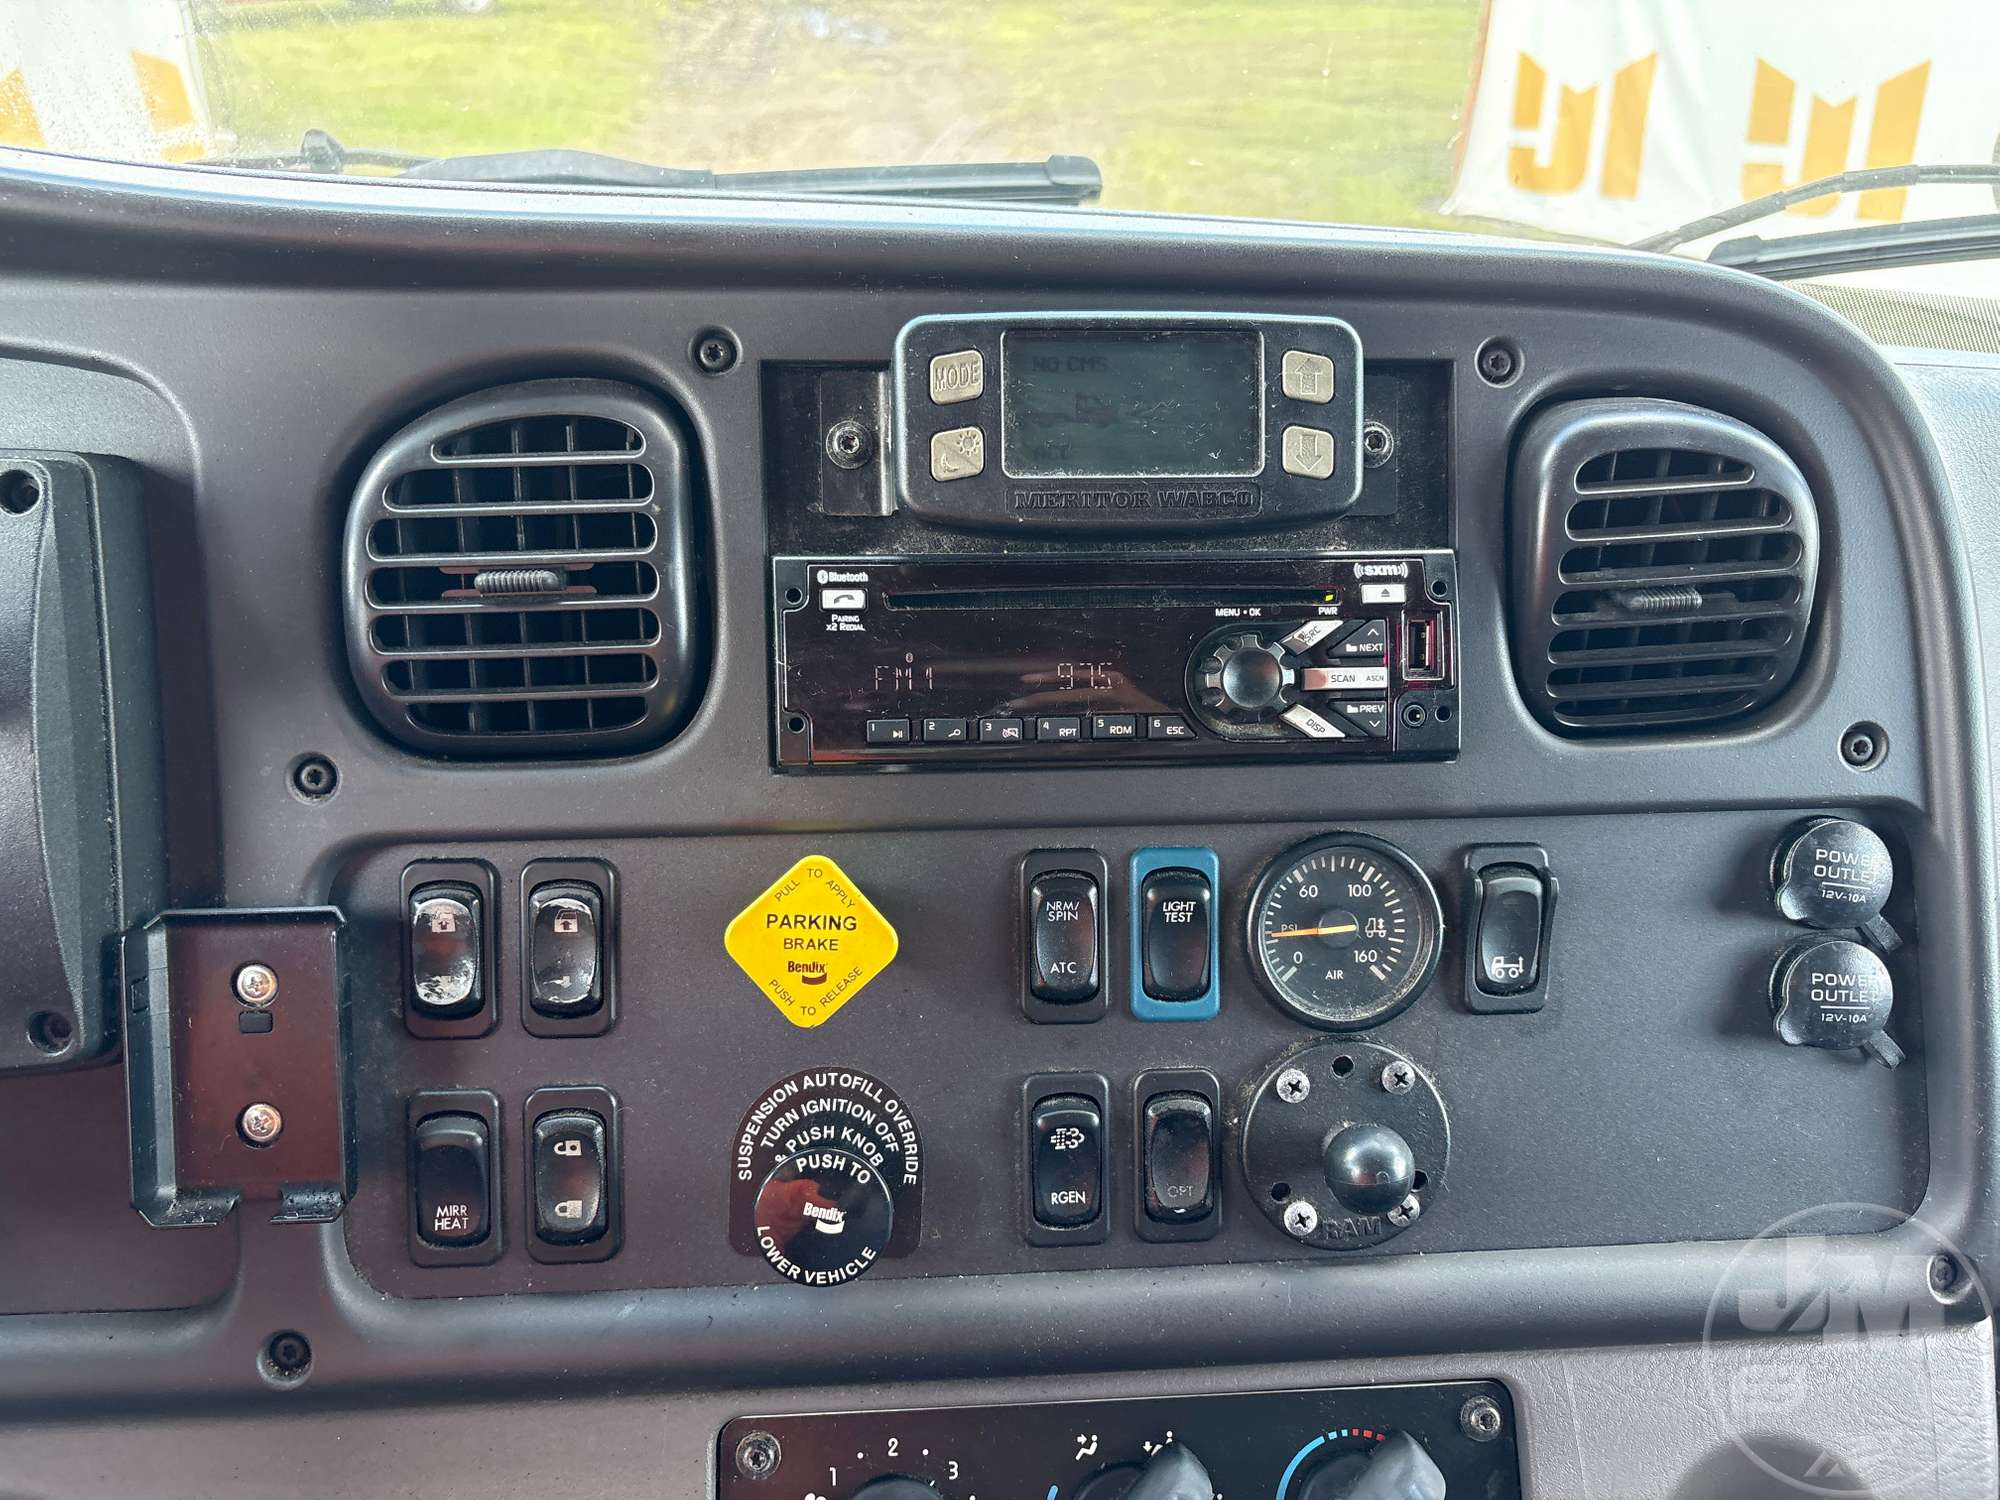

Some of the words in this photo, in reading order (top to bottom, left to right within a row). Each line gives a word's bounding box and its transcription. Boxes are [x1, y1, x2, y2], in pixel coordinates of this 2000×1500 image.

[934, 360, 980, 391] MODE
[1015, 490, 1152, 509] MERITOR
[1156, 490, 1254, 508] WABCO
[828, 571, 869, 582] Bluetooth
[1215, 608, 1240, 617] MENU
[1249, 607, 1261, 616] OK
[1318, 606, 1338, 615] PWR
[1359, 643, 1384, 652] NEXT
[1330, 674, 1355, 683] SCAN
[1359, 704, 1384, 713] PREV
[871, 723, 876, 731] 1
[928, 722, 936, 731] 2
[985, 722, 992, 731] 3
[1042, 721, 1050, 730] 4
[1097, 719, 1105, 728] 5
[1109, 725, 1132, 734] RDM
[1153, 719, 1161, 728] 6
[1166, 726, 1185, 735] ESC
[1306, 718, 1326, 733] DISP
[1059, 728, 1077, 737] RPT
[1813, 865, 1880, 883] OUTLET
[774, 879, 801, 902] PULL
[807, 868, 823, 879] TO
[825, 879, 856, 908] APPLY
[1299, 884, 1319, 898] 60
[1348, 884, 1372, 898] 100
[1822, 889, 1867, 904] 12V-10A
[1162, 901, 1197, 912] LIGHT
[766, 913, 857, 931] PARKING
[1047, 911, 1079, 922] SPIN
[1164, 912, 1193, 923] TEST
[783, 937, 839, 951] BRAKE
[1293, 951, 1303, 964] 0
[1354, 949, 1378, 963] 160
[787, 960, 826, 974] Bendix
[1050, 962, 1077, 974] ATC
[1325, 970, 1344, 980] AIR
[768, 979, 796, 1007] PUSH
[800, 1006, 817, 1016] TO
[819, 966, 863, 1007] RELEASE
[1821, 1013, 1868, 1024] 12V-10A
[738, 1080, 799, 1180] SUSPENSION
[803, 1072, 883, 1103] AUTOFILL
[884, 1099, 919, 1185] OVERRIDE
[761, 1109, 800, 1149] TURN
[801, 1098, 876, 1126] IGNITION
[874, 1122, 900, 1153] OFF
[785, 1126, 835, 1153] PUSH
[841, 1126, 884, 1168] KNOB
[795, 1154, 846, 1173] PUSH
[850, 1161, 871, 1185] TO
[1051, 1190, 1086, 1205] RGEN
[436, 1205, 468, 1218] MIRR
[803, 1202, 846, 1222] Bendix
[434, 1217, 469, 1231] HEAT
[1321, 1215, 1382, 1240] RAM
[756, 1225, 801, 1280] LOWER
[804, 1246, 877, 1285] VEHICLE
[887, 1437, 899, 1457] 2
[829, 1466, 837, 1487] 1
[948, 1461, 959, 1480] 3
